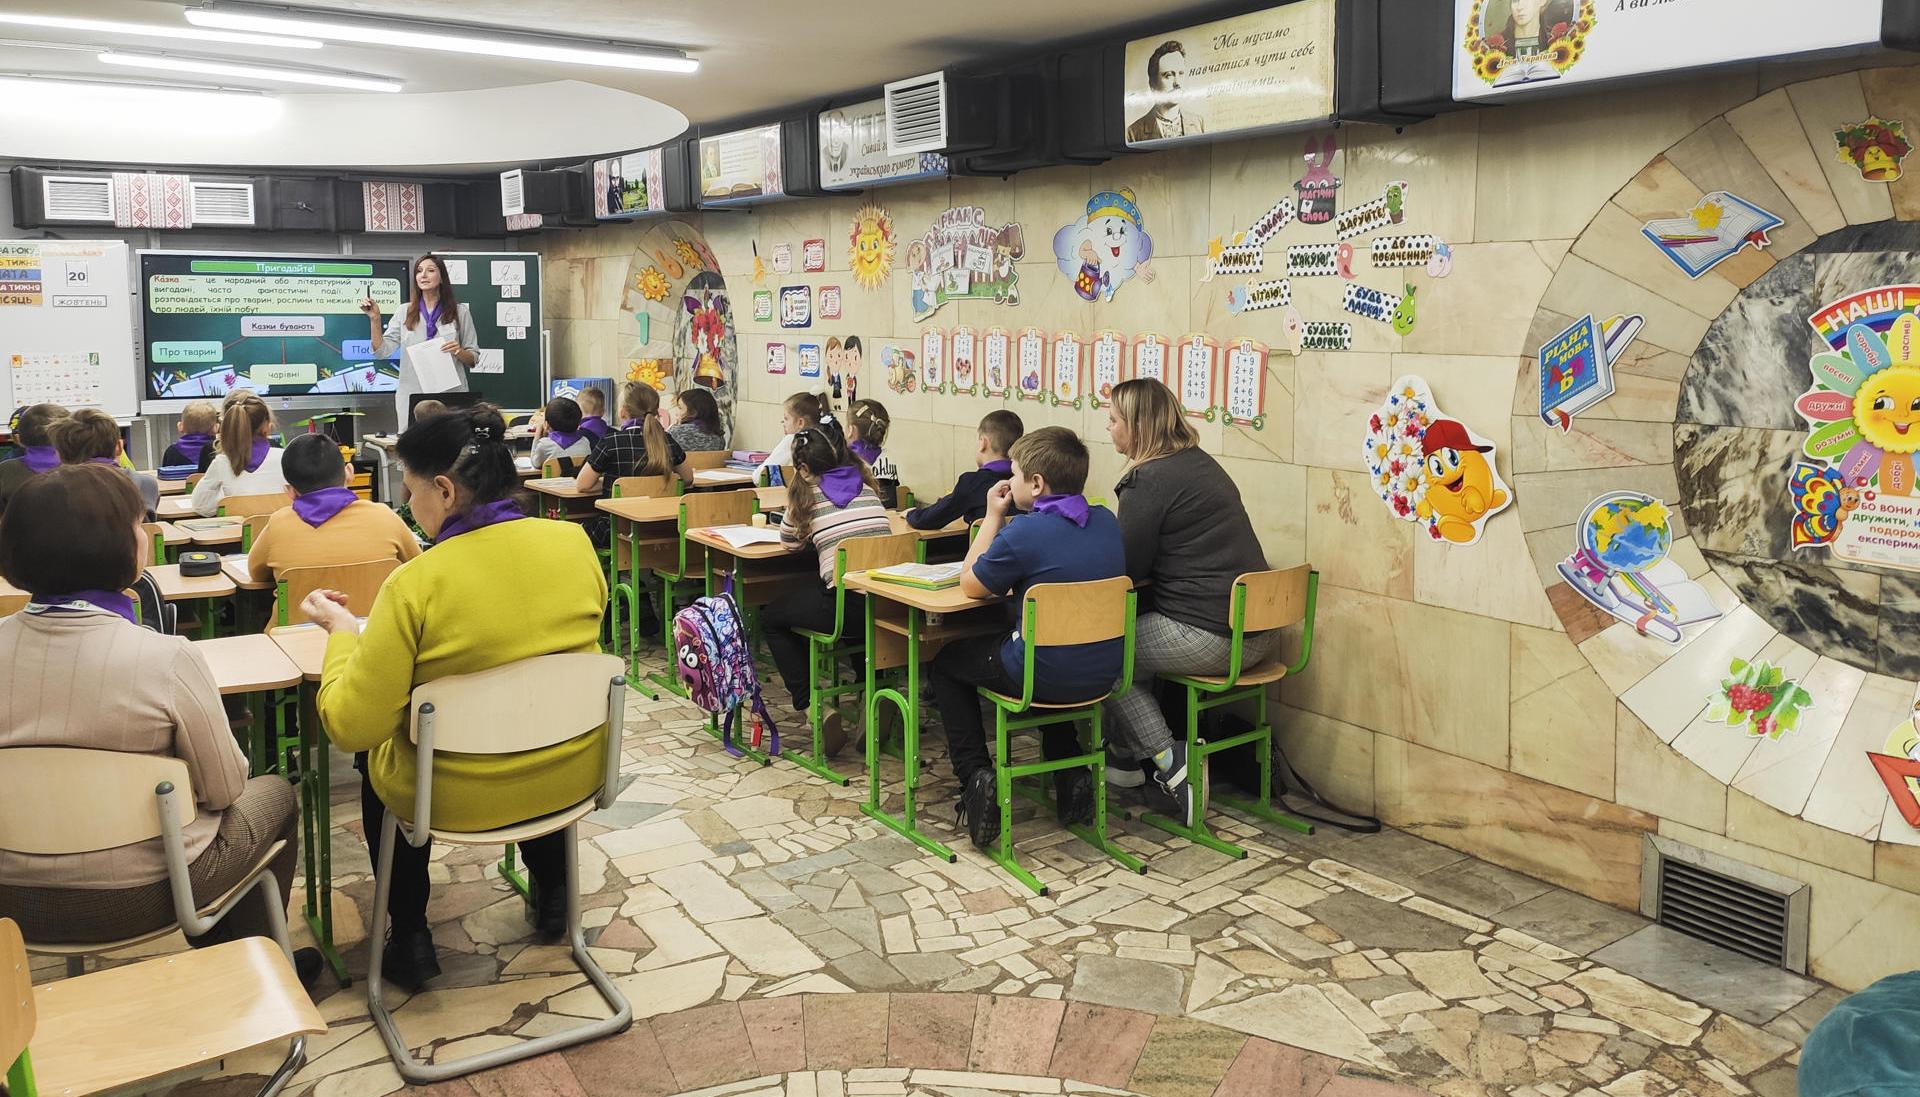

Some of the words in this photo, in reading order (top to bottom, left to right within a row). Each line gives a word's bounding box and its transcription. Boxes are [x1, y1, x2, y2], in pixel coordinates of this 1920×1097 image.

[1242, 27, 1290, 46] мусимо
[1189, 60, 1250, 76] навчатися
[1254, 50, 1287, 67] чути
[1290, 41, 1315, 59] себе
[1392, 239, 1406, 250] ДО
[256, 263, 316, 274] Пригадайте!
[69, 272, 86, 281] 20
[225, 277, 266, 286] народний
[1355, 287, 1383, 304] БУДЬ
[1826, 290, 1904, 331] НАШІ
[280, 323, 315, 331] бувають
[1307, 326, 1343, 336] БУДЬТЕ
[1195, 338, 1200, 347] 9
[1241, 342, 1251, 353] 10
[1544, 325, 1588, 364] РІДНА
[1902, 320, 1911, 361] щасливі
[160, 348, 180, 358] Про
[1559, 339, 1589, 365] МОВА
[1855, 331, 1880, 366] хоробрі
[1823, 363, 1854, 384] веселі
[1808, 401, 1846, 411] дружні
[1815, 427, 1856, 452] розумні
[1849, 451, 1872, 476] чемні
[1892, 462, 1902, 488] добрі
[1861, 503, 1876, 511] БО
[1880, 505, 1912, 514] ВОНИ
[1853, 514, 1909, 527] дружити,
